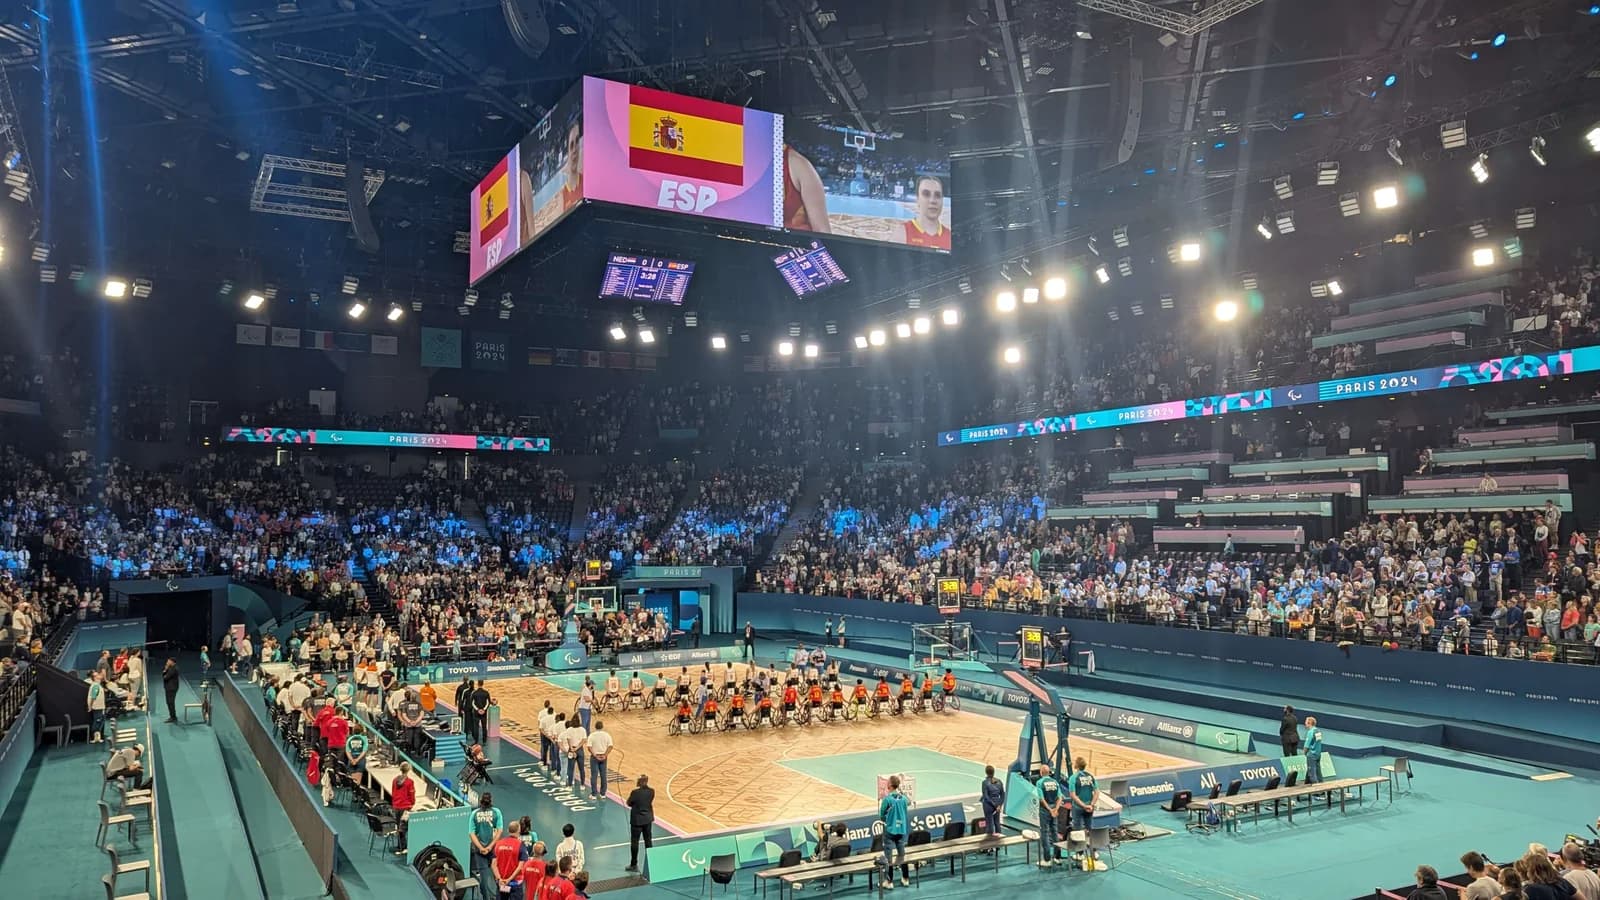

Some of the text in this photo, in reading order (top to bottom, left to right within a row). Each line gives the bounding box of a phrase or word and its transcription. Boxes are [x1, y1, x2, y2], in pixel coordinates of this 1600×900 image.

[658, 179, 718, 213] ESP
[486, 239, 502, 270] ESP
[475, 342, 505, 353] PARIS
[475, 351, 505, 361] 2024
[1336, 376, 1418, 394] PARIS 2024
[1118, 407, 1174, 420] PARIS 2024
[969, 427, 1008, 438] PARIS 2024
[389, 436, 447, 445] PARIS 2024
[448, 666, 479, 674] TOYOTA
[1083, 707, 1097, 719] All
[1156, 721, 1183, 734] Allianz
[1240, 766, 1279, 781] TOYOTA
[1201, 772, 1216, 790] All
[1129, 781, 1175, 797] Panasonic
